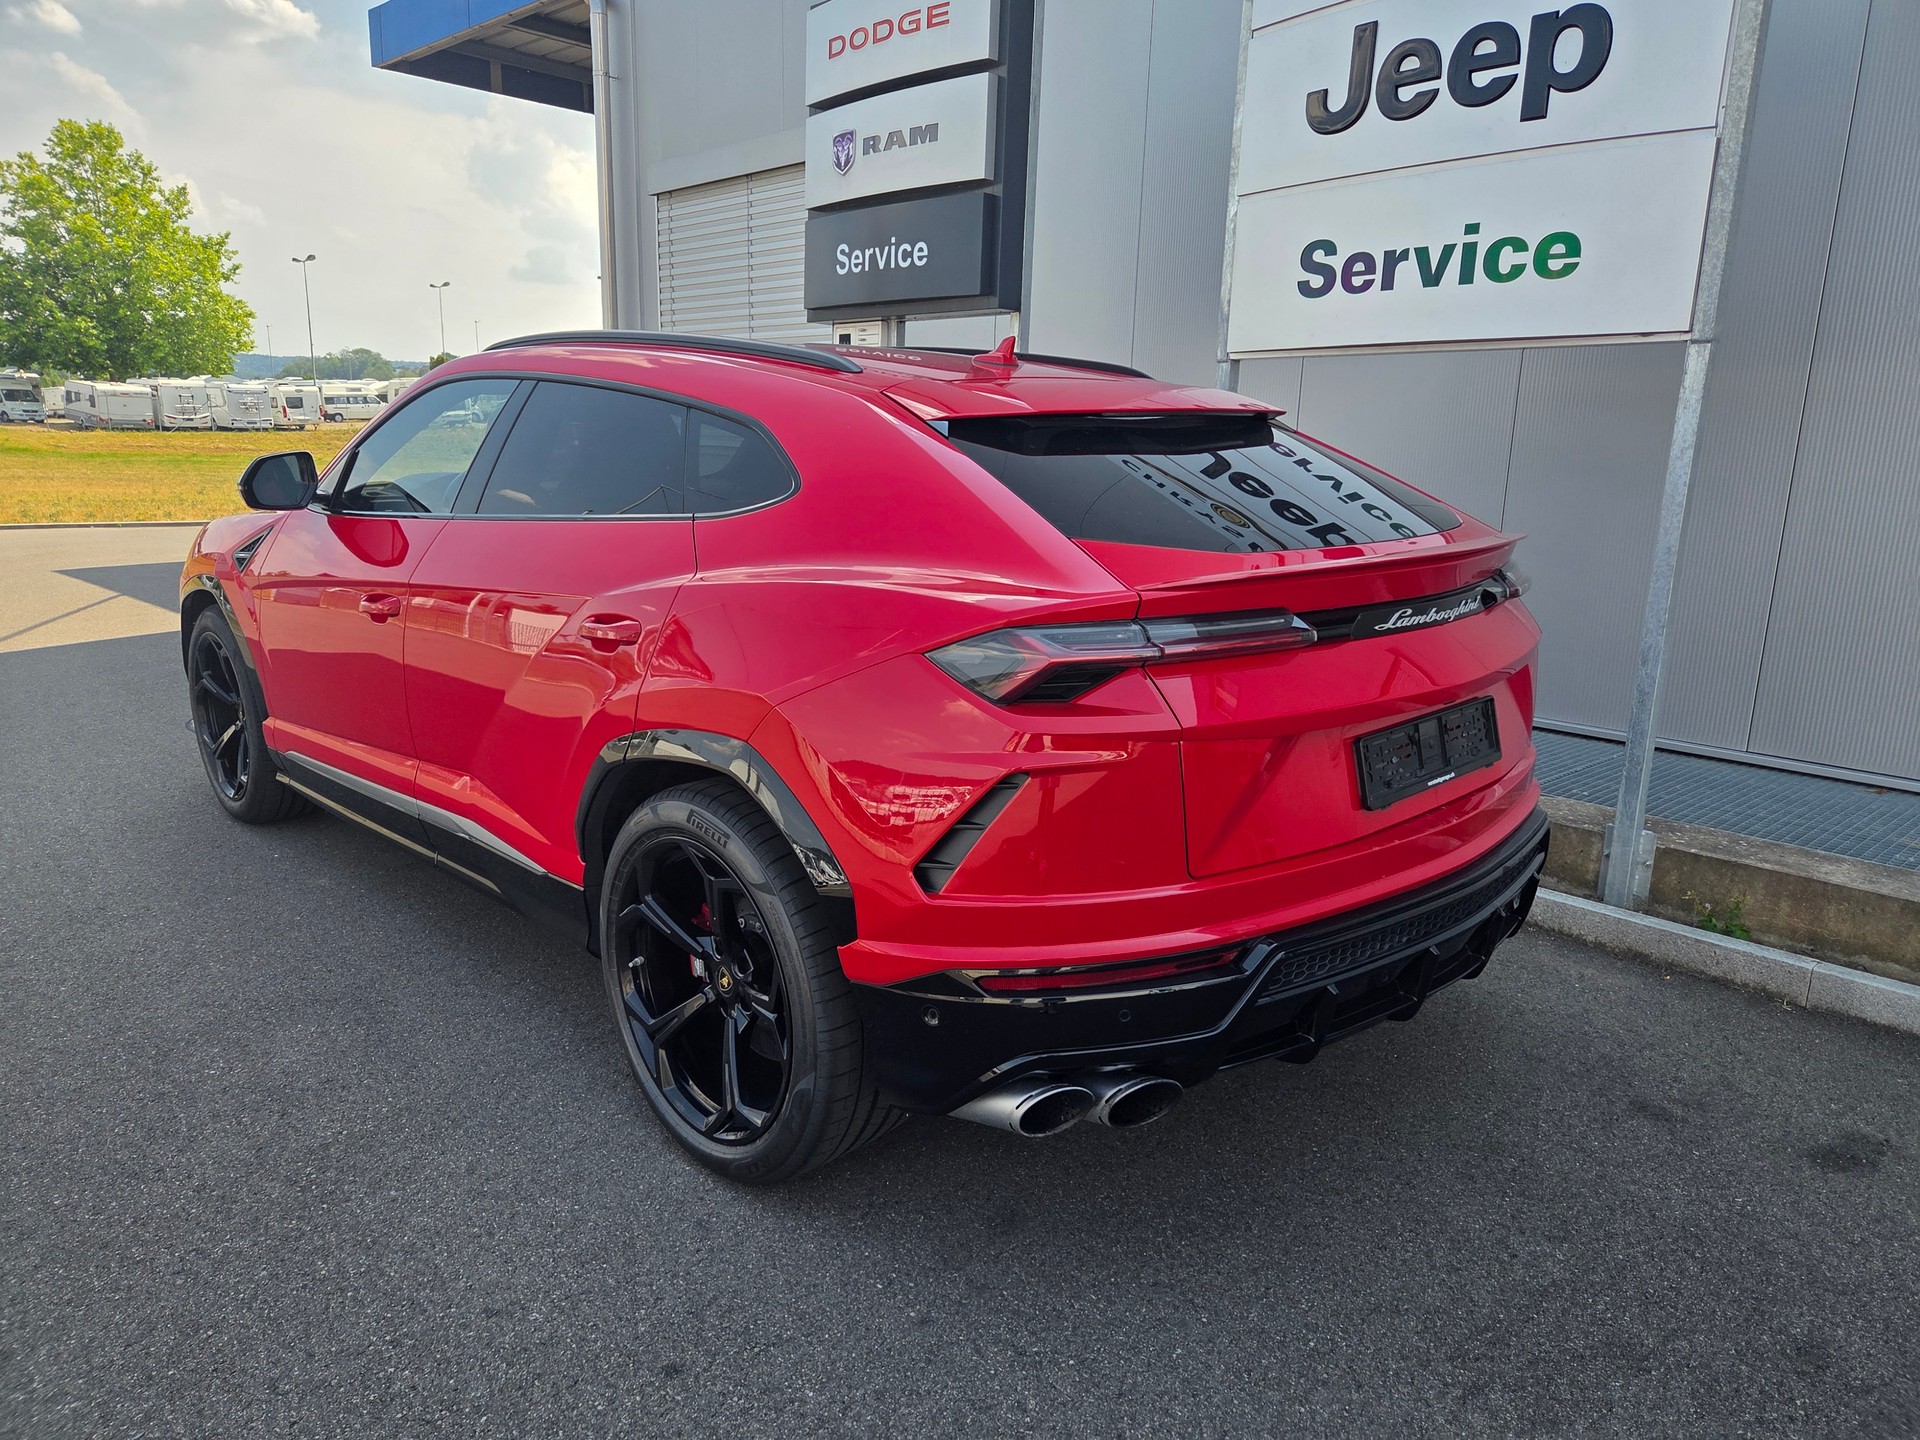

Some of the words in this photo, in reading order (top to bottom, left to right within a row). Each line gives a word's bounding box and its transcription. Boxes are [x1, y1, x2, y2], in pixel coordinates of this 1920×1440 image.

[828, 1, 950, 60] DODGE
[1305, 2, 1614, 136] Jeep
[862, 122, 939, 157] RAM
[835, 236, 929, 276] Service
[1296, 221, 1582, 300] Service
[1374, 596, 1481, 631] Lamborghini
[686, 808, 731, 849] PIRELLI
